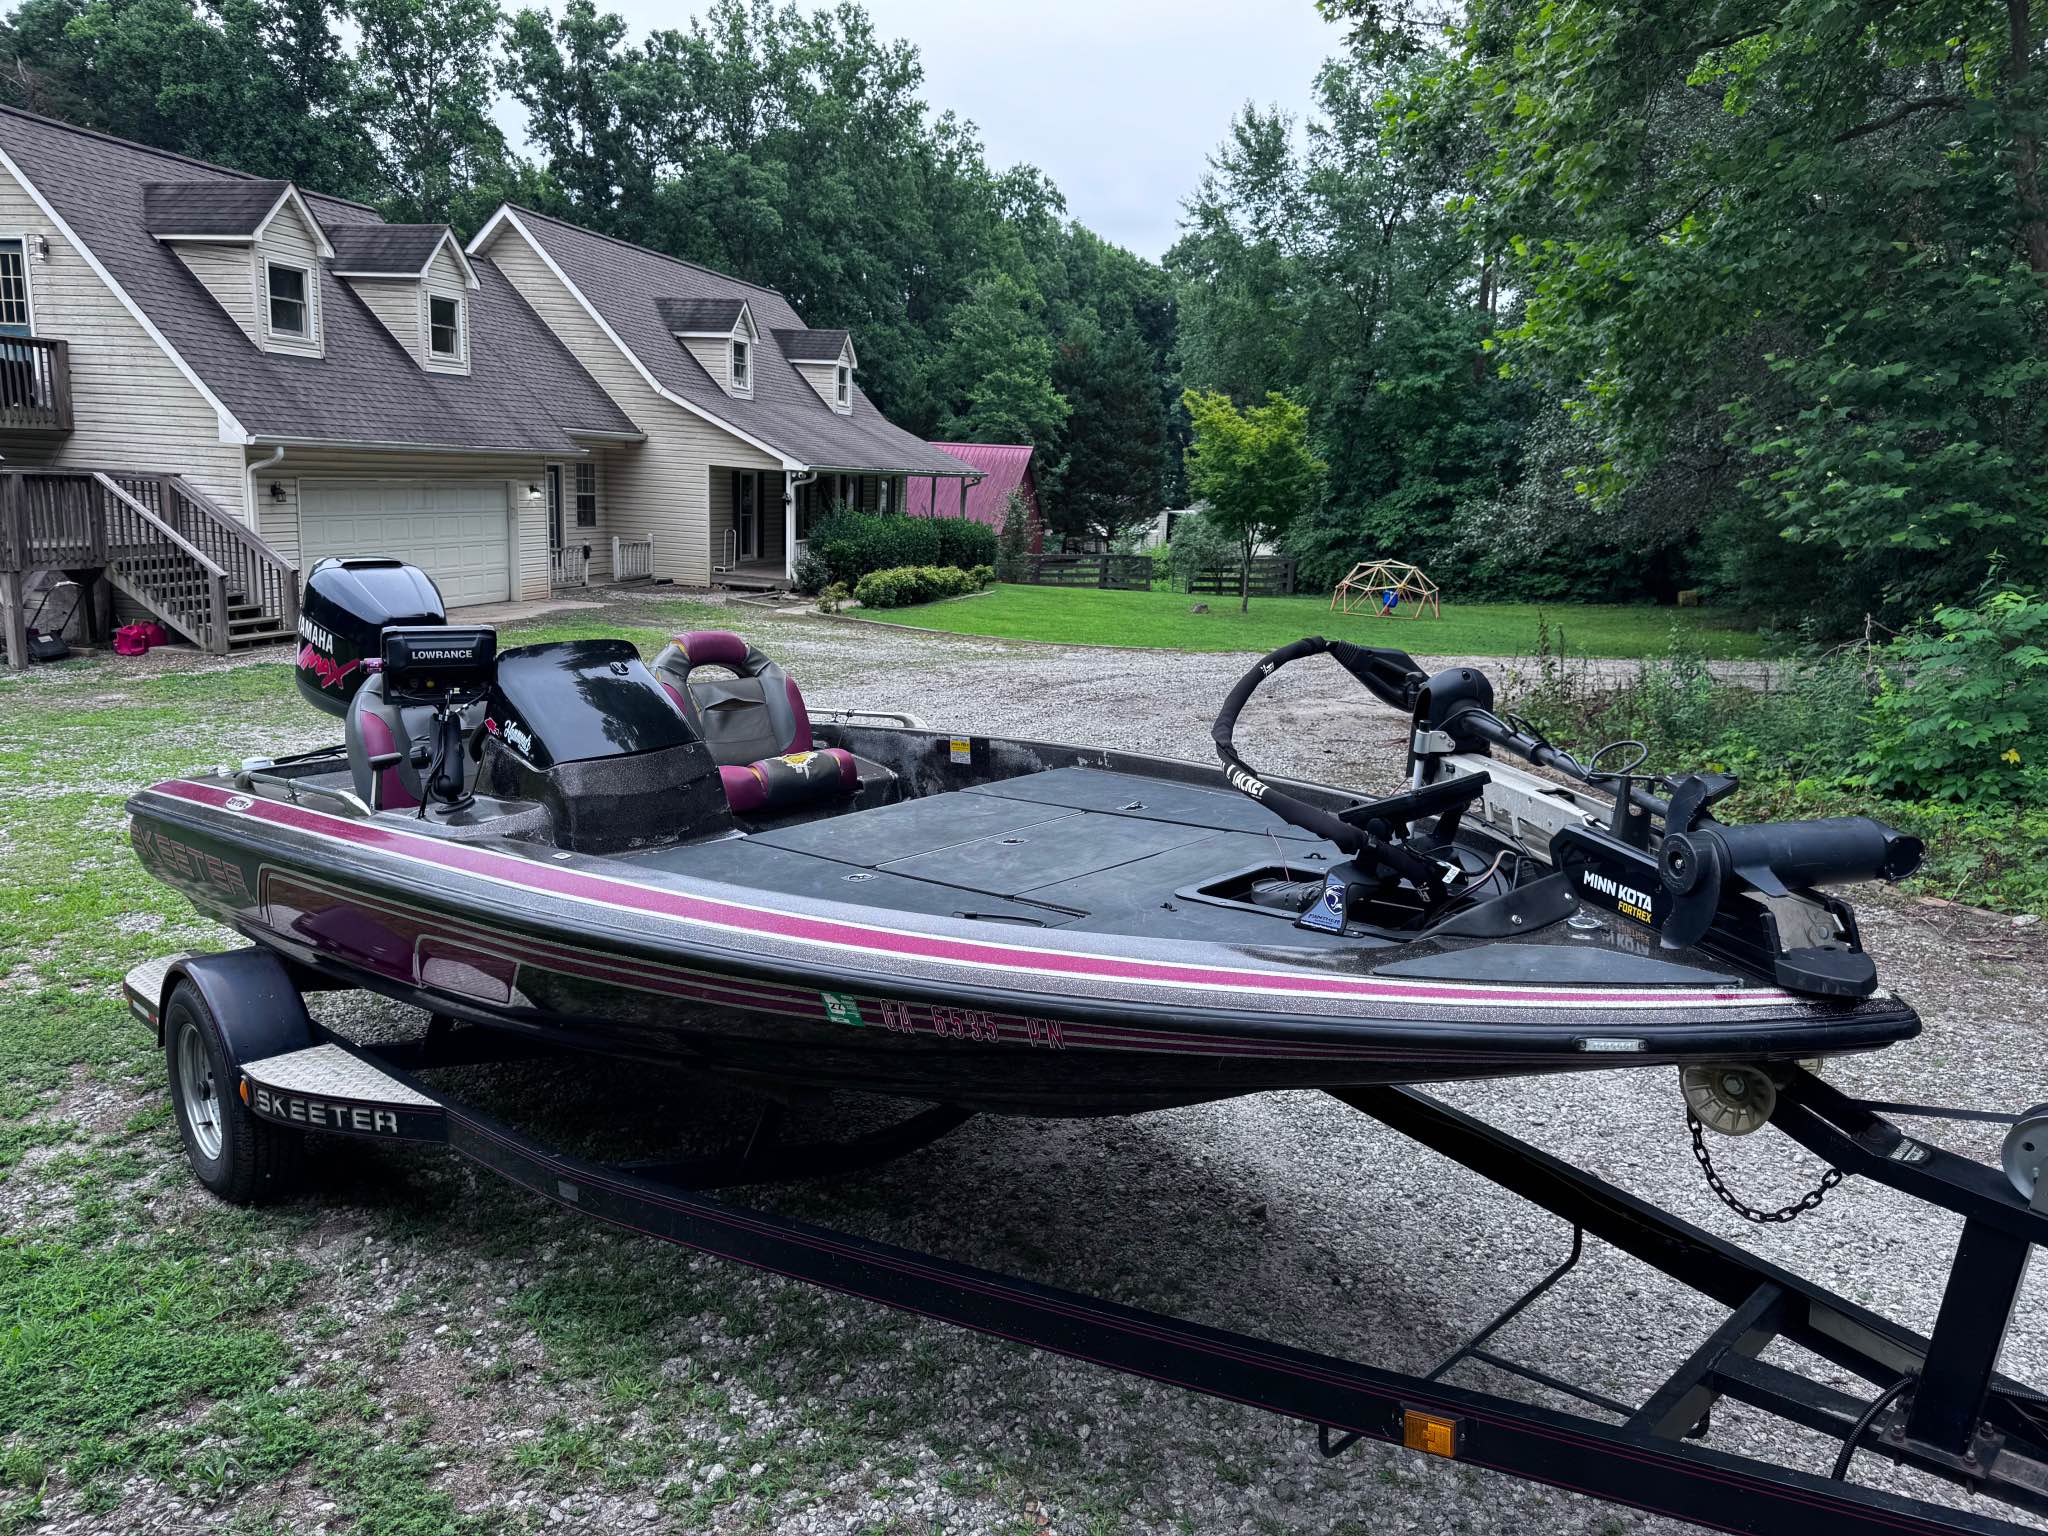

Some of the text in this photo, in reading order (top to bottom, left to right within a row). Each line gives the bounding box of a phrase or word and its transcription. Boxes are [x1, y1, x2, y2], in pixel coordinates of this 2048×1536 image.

[412, 650, 473, 660] LOWRANCE
[1583, 870, 1652, 912] MINN KOTA
[1617, 901, 1652, 924] FORTREX
[880, 998, 916, 1034] GA
[930, 1004, 1000, 1044] 6535
[256, 1089, 398, 1134] SKEETER
